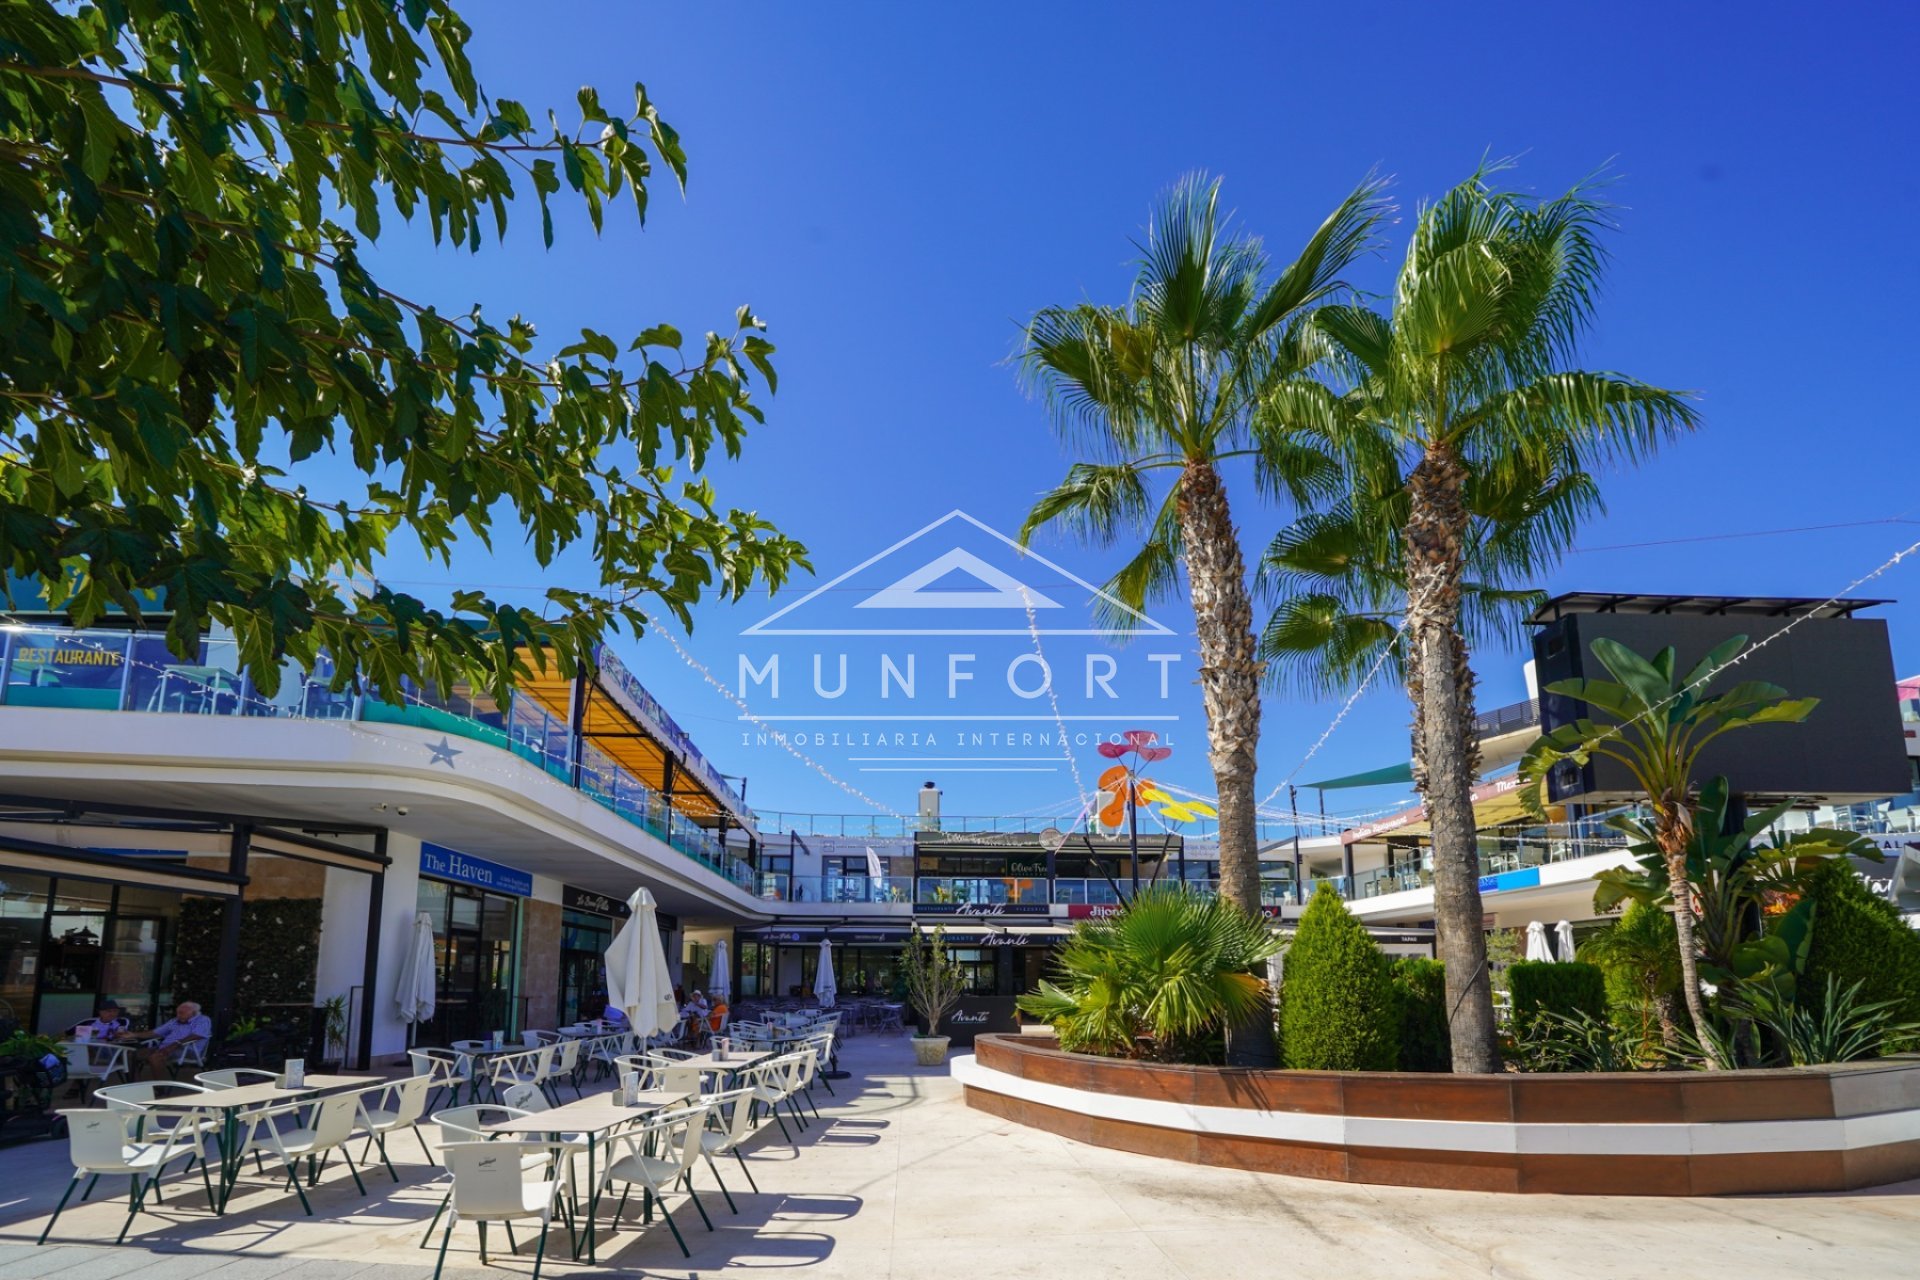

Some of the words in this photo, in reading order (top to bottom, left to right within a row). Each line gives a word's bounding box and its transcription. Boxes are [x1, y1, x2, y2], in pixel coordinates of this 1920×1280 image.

[18, 647, 121, 666] RESTAURANTE
[424, 853, 446, 872] The
[447, 854, 493, 884] Haven
